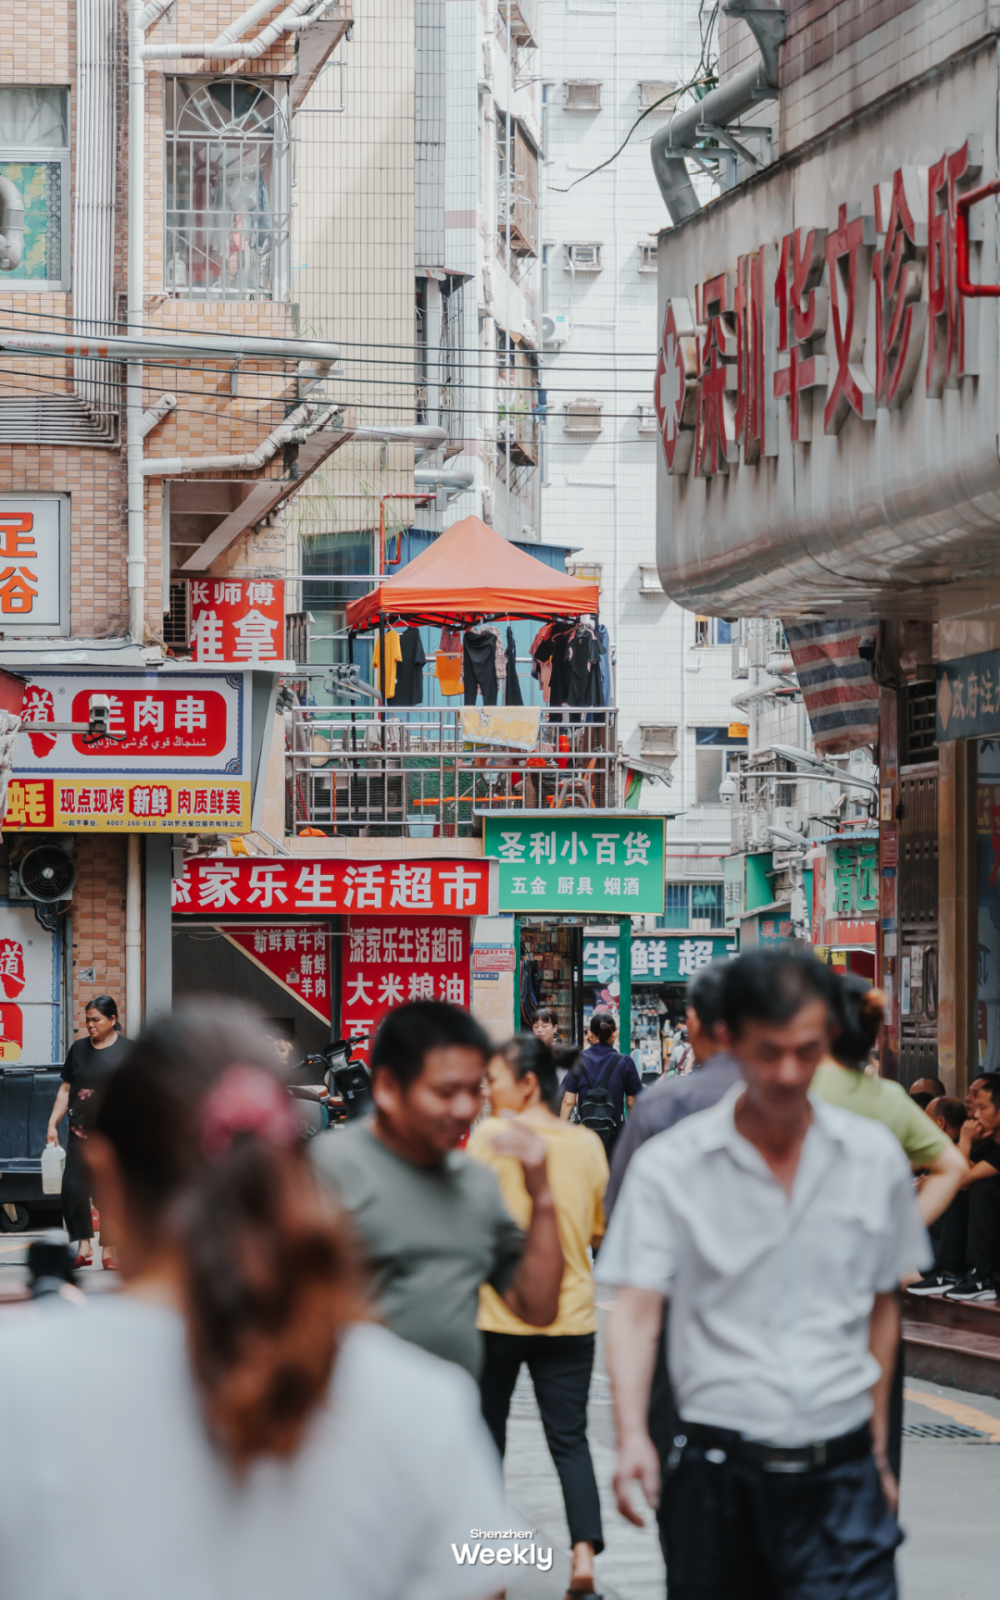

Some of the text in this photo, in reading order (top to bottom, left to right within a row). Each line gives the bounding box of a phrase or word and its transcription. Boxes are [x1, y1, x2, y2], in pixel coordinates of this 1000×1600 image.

[60, 786, 241, 816] 现点现烤 新鲜 肉质鲜美
[498, 831, 651, 867] 圣利小百货
[511, 876, 640, 896] 五金 厨具 烟酒
[254, 928, 326, 952] 新鲜黄牛肉
[301, 954, 326, 975] 新鲜
[582, 939, 740, 977] 生鲜超
[301, 977, 326, 998] 羊肉
[346, 972, 465, 1006] 大米粮油
[345, 1020, 382, 1051] 百
